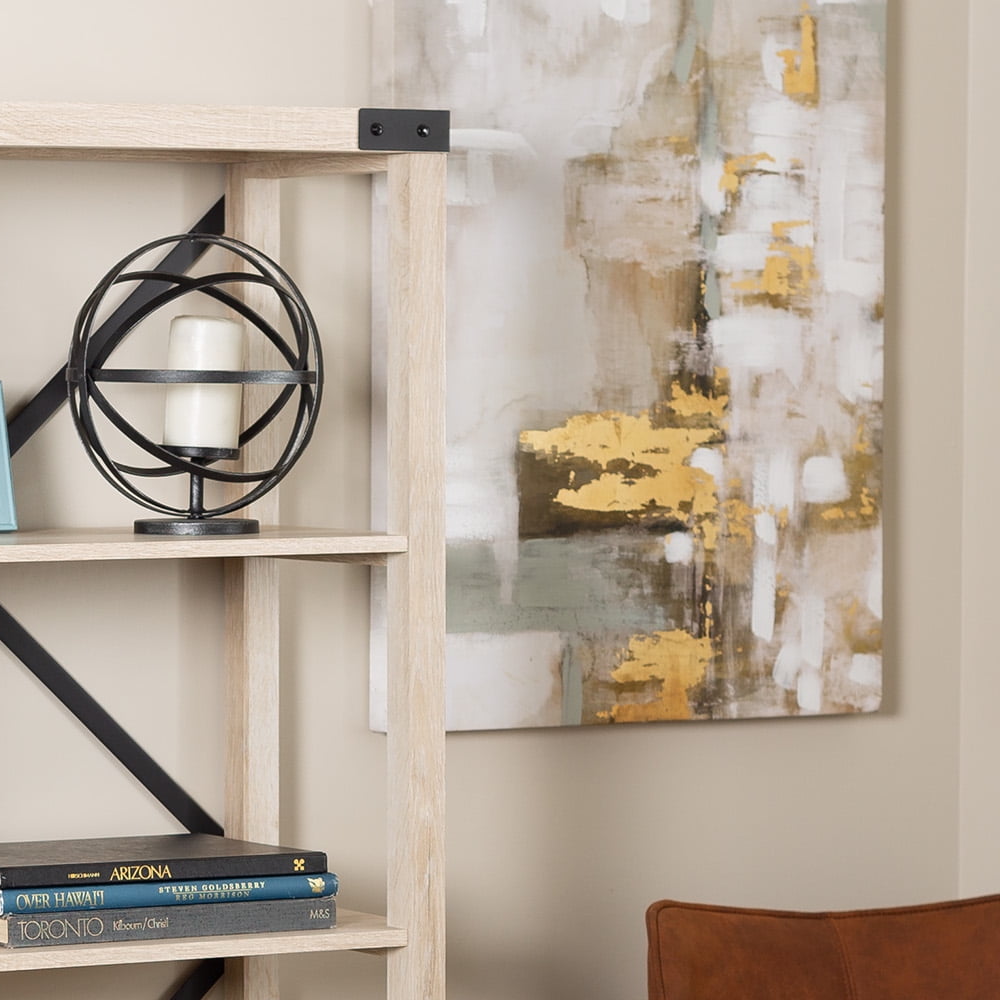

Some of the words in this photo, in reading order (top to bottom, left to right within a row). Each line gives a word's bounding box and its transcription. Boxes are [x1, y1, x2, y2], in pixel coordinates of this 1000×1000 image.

[110, 864, 173, 881] ARIZONA
[158, 885, 198, 894] STEVEN
[201, 881, 266, 892] GOLDSBERRY
[199, 890, 251, 900] MORRISON
[16, 893, 51, 911] OVER
[310, 908, 330, 920] M&S
[17, 917, 104, 941] TORONTO
